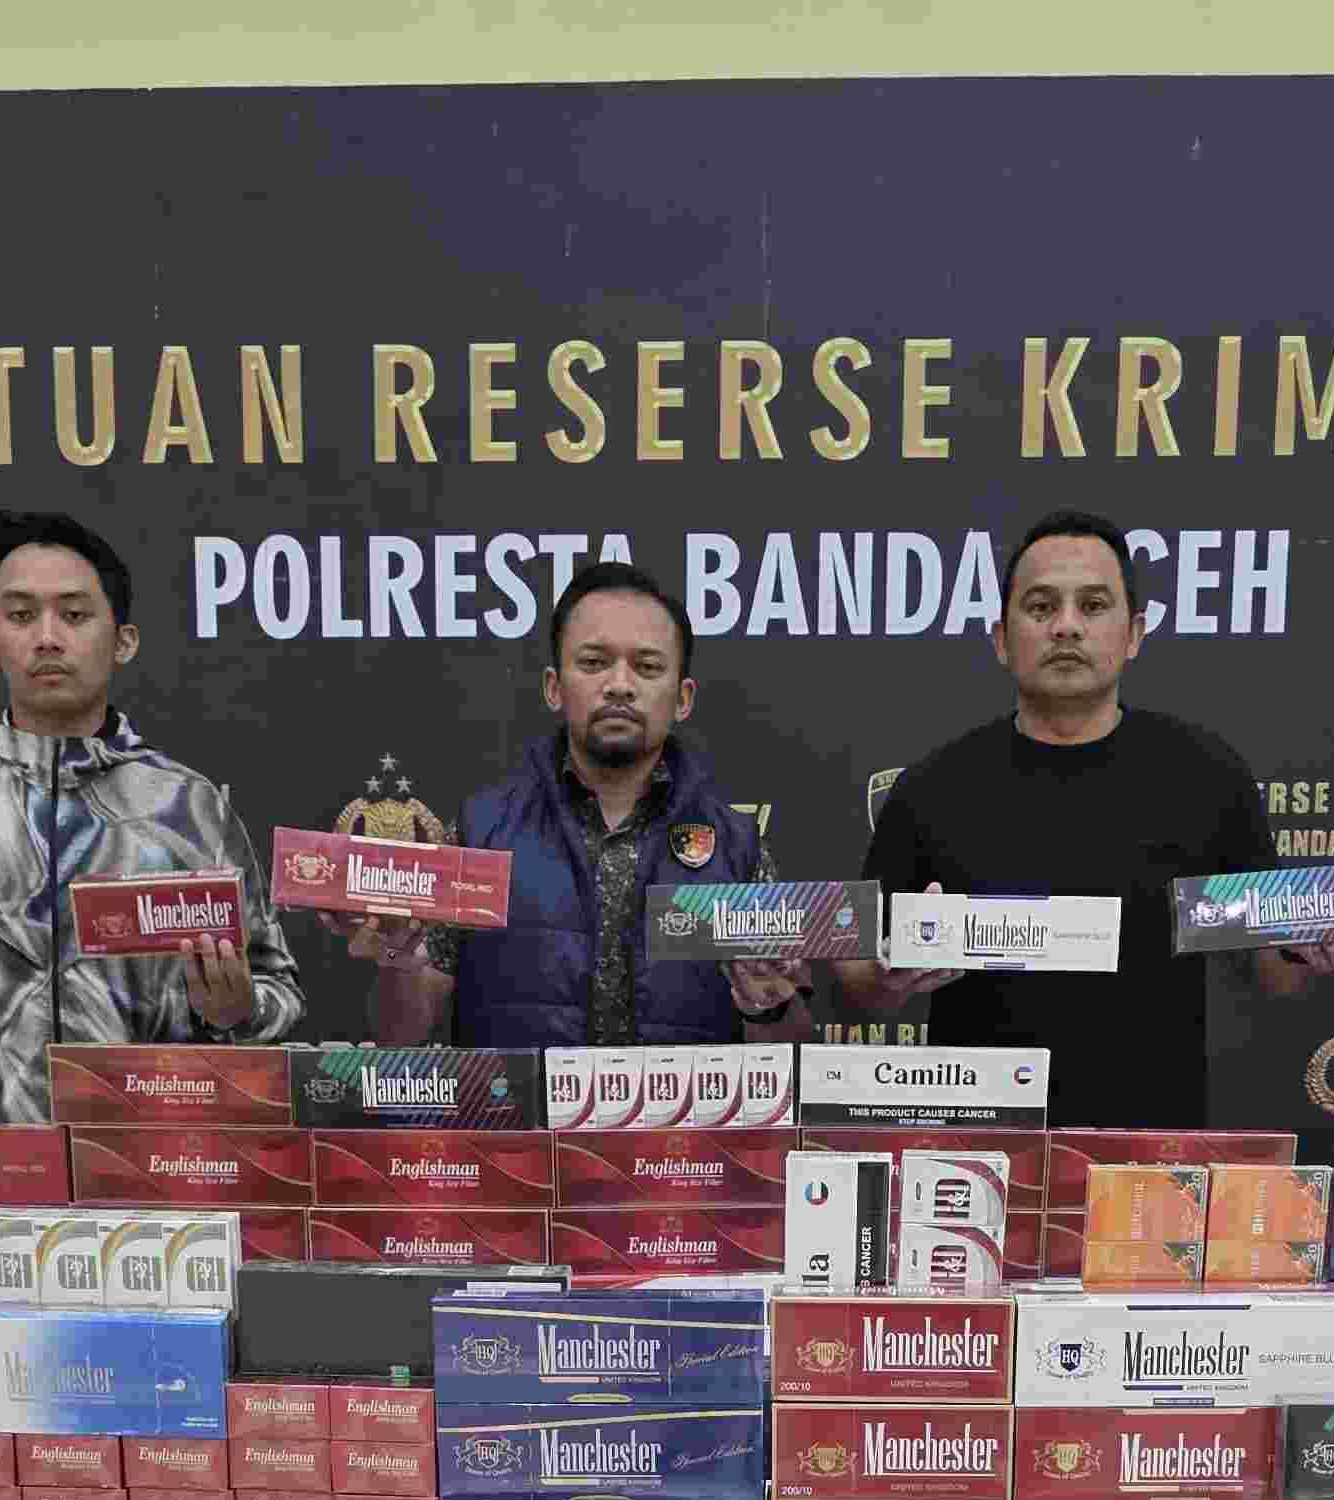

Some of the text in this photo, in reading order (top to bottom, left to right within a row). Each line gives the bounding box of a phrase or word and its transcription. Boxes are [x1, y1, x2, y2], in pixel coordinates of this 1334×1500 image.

[372, 336, 953, 464] RESERSE
[684, 529, 1003, 638] BANDA
[1124, 527, 1291, 635] CEH
[346, 853, 438, 898] Manchester
[137, 891, 234, 936] Manchester
[963, 912, 1051, 952] Manchester
[124, 1073, 216, 1096] Englishman
[361, 1066, 459, 1109] Manchester
[826, 1062, 977, 1086] CM Camilla
[849, 1108, 997, 1119] THIS PRODUCT CAUSES CANCER
[149, 1154, 239, 1175] Englishman
[632, 1157, 725, 1179] Englishman
[627, 1235, 719, 1257] Englishman
[538, 1324, 661, 1375] Manchester
[1121, 1329, 1251, 1382] Manchester
[1258, 1352, 1310, 1366] SAPPHIRE
[780, 1382, 812, 1392] 200/10
[863, 1422, 1000, 1473] Manchester
